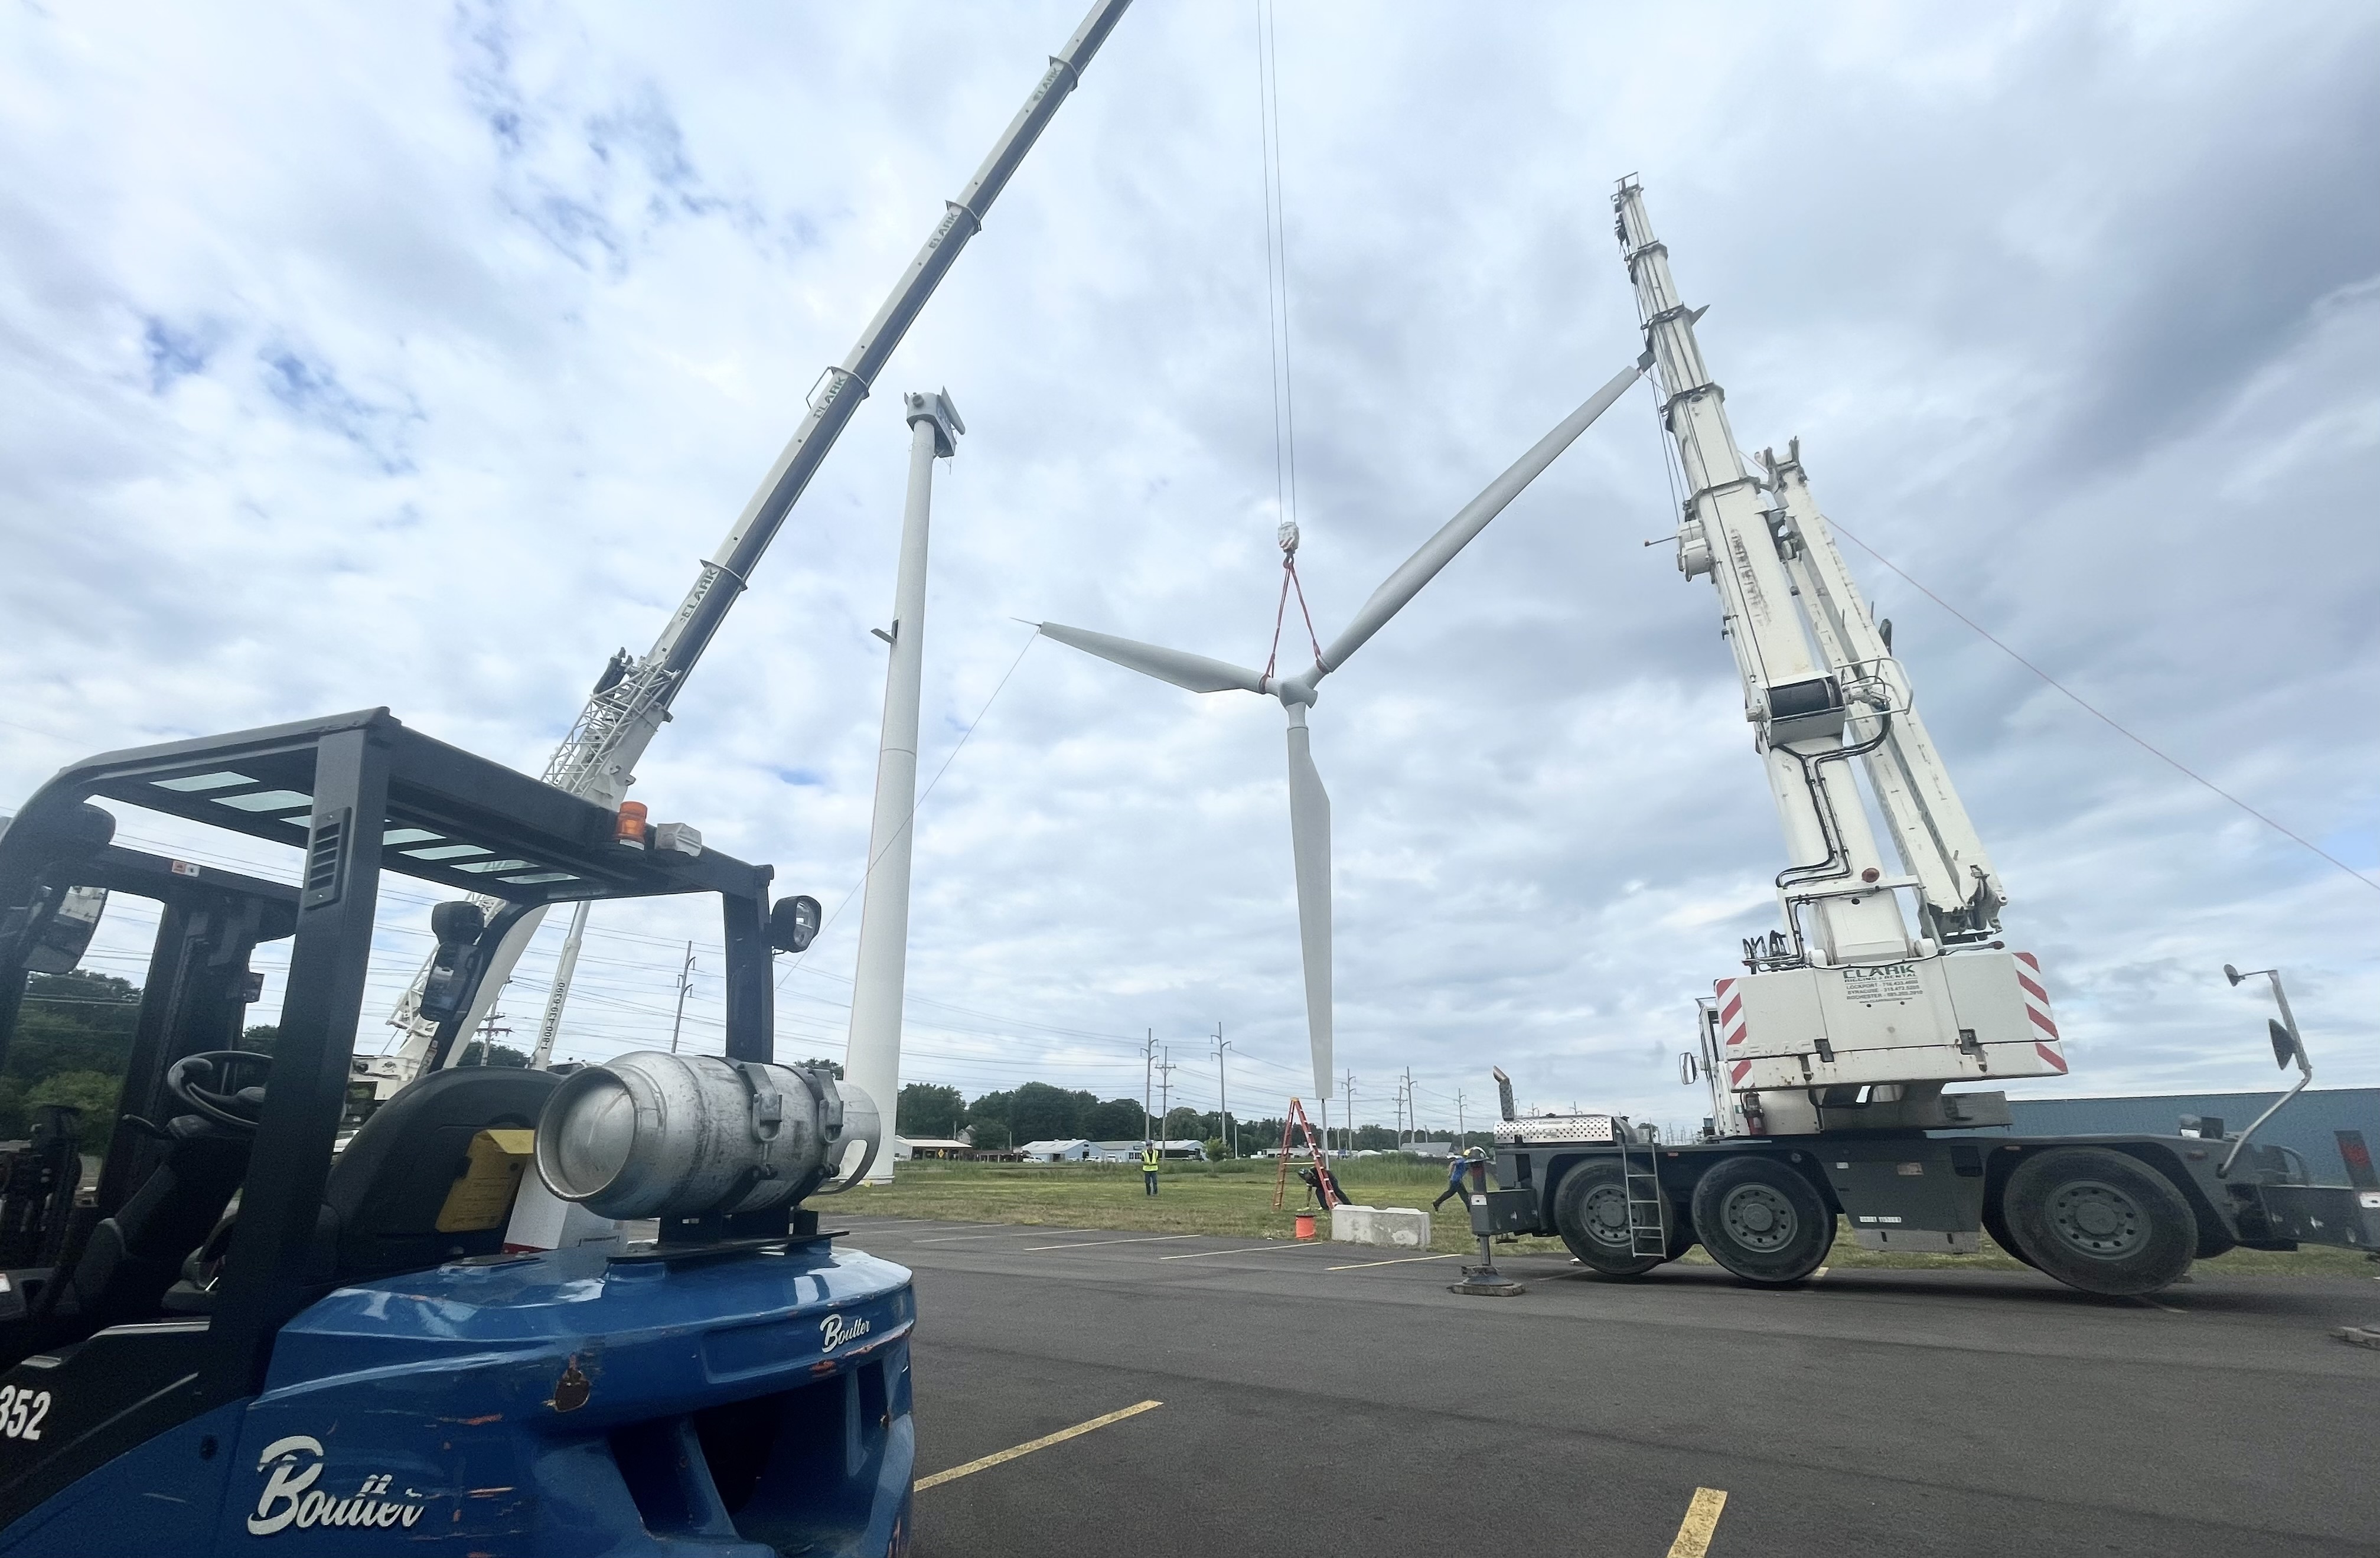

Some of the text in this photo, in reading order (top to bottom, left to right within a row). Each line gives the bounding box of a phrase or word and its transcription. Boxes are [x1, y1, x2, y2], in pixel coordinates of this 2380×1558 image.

[813, 376, 846, 419] CLARK
[1843, 964, 1915, 979] CLARK
[540, 982, 566, 1051] 1-800-439-6390
[819, 1313, 871, 1354] Boulter
[0, 1384, 51, 1440] 352
[247, 1435, 425, 1536] Boulter
